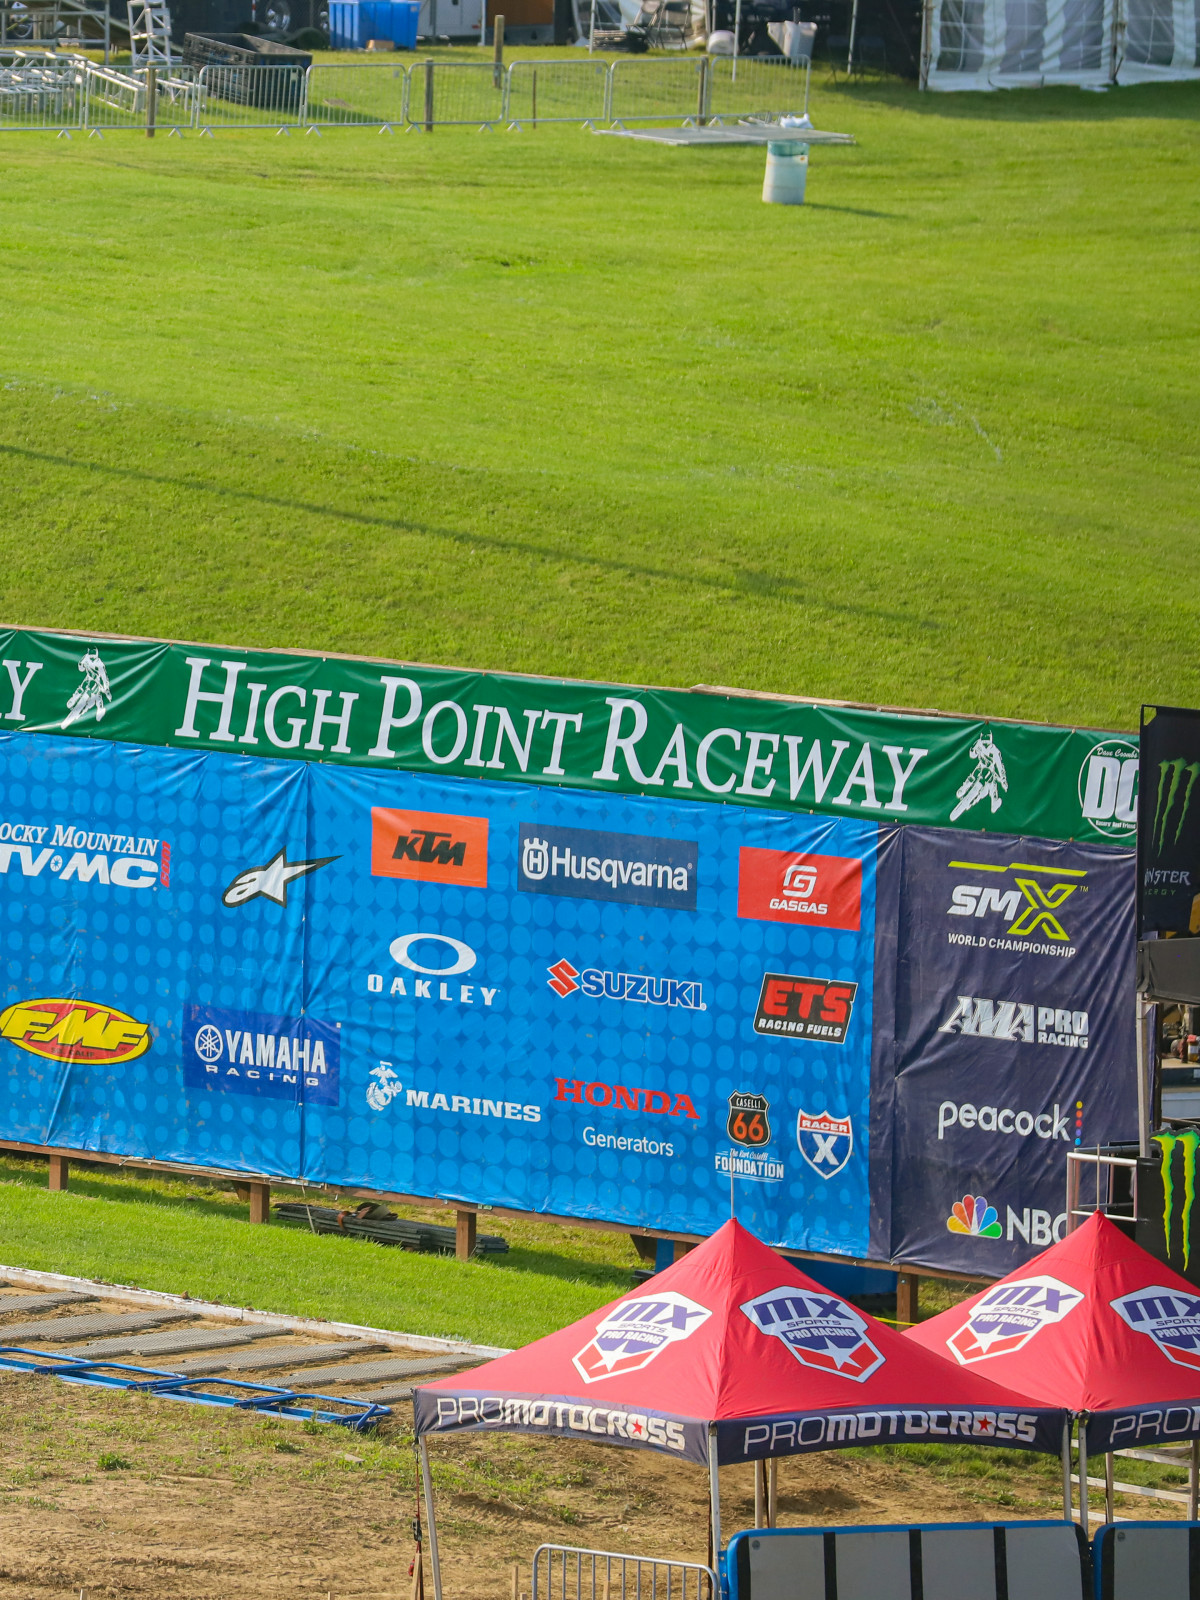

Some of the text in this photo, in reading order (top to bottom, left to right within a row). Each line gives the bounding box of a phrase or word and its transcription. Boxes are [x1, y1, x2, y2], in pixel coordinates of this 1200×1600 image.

[175, 656, 928, 811] HIGH POINT RACEWAY
[49, 824, 159, 857] MOUNTAIN
[392, 829, 467, 867] KTM
[551, 844, 688, 891] Husqvarna
[769, 898, 828, 915] GASGAS
[947, 878, 1078, 941] SMX
[948, 933, 1076, 958] WORLD CHAMPIONSHIP
[367, 974, 497, 1006] OAKLEY
[581, 968, 703, 1010] SUZUKI
[763, 979, 851, 1023] ETS
[0, 1008, 149, 1051] FMF
[806, 1023, 842, 1038] FUELS
[938, 995, 1035, 1043] AMA
[1037, 1006, 1089, 1035] PRO
[225, 1029, 326, 1075] YAMAHA
[1037, 1031, 1088, 1049] RACING
[205, 1064, 318, 1086] RACING
[406, 1089, 541, 1122] MARINES
[554, 1077, 700, 1120] HONDA
[736, 1097, 761, 1109] CASELLI
[733, 1112, 764, 1141] 66
[802, 1119, 848, 1132] RACER
[938, 1100, 1071, 1141] peacock
[583, 1126, 673, 1157] Generators
[812, 1133, 839, 1165] X
[715, 1155, 784, 1179] FOUNDATION
[753, 1297, 855, 1326] MX
[981, 1286, 1079, 1313] MX
[992, 1307, 1041, 1316] SPORTS
[608, 1302, 707, 1331] MX
[617, 1322, 667, 1333] SPORTS
[786, 1319, 841, 1328] SPORTS
[976, 1314, 1038, 1328] PRO RACING
[602, 1331, 664, 1345] PRO RACING
[786, 1328, 856, 1340] PRO RACING
[1155, 1328, 1180, 1338] PRO
